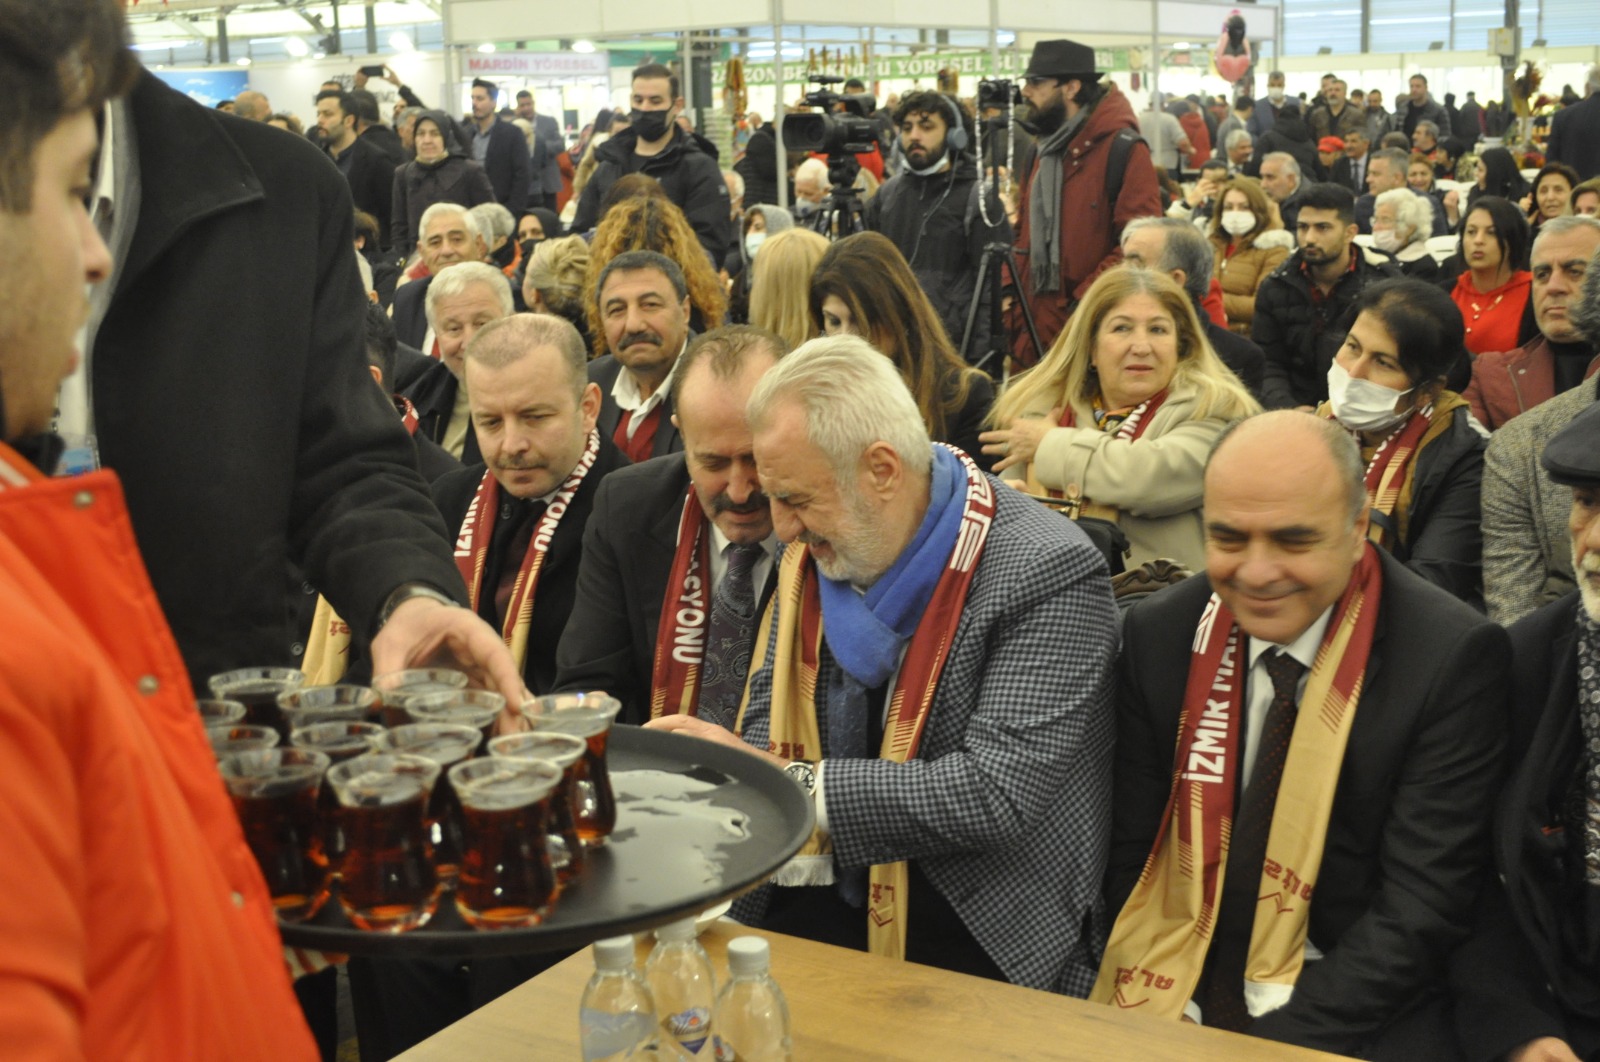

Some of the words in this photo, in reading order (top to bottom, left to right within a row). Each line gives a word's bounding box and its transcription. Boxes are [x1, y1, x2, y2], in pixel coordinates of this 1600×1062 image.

[469, 57, 528, 70] MARDİN
[534, 56, 597, 70] YÖRESEL
[896, 56, 985, 75] YÖRESEL
